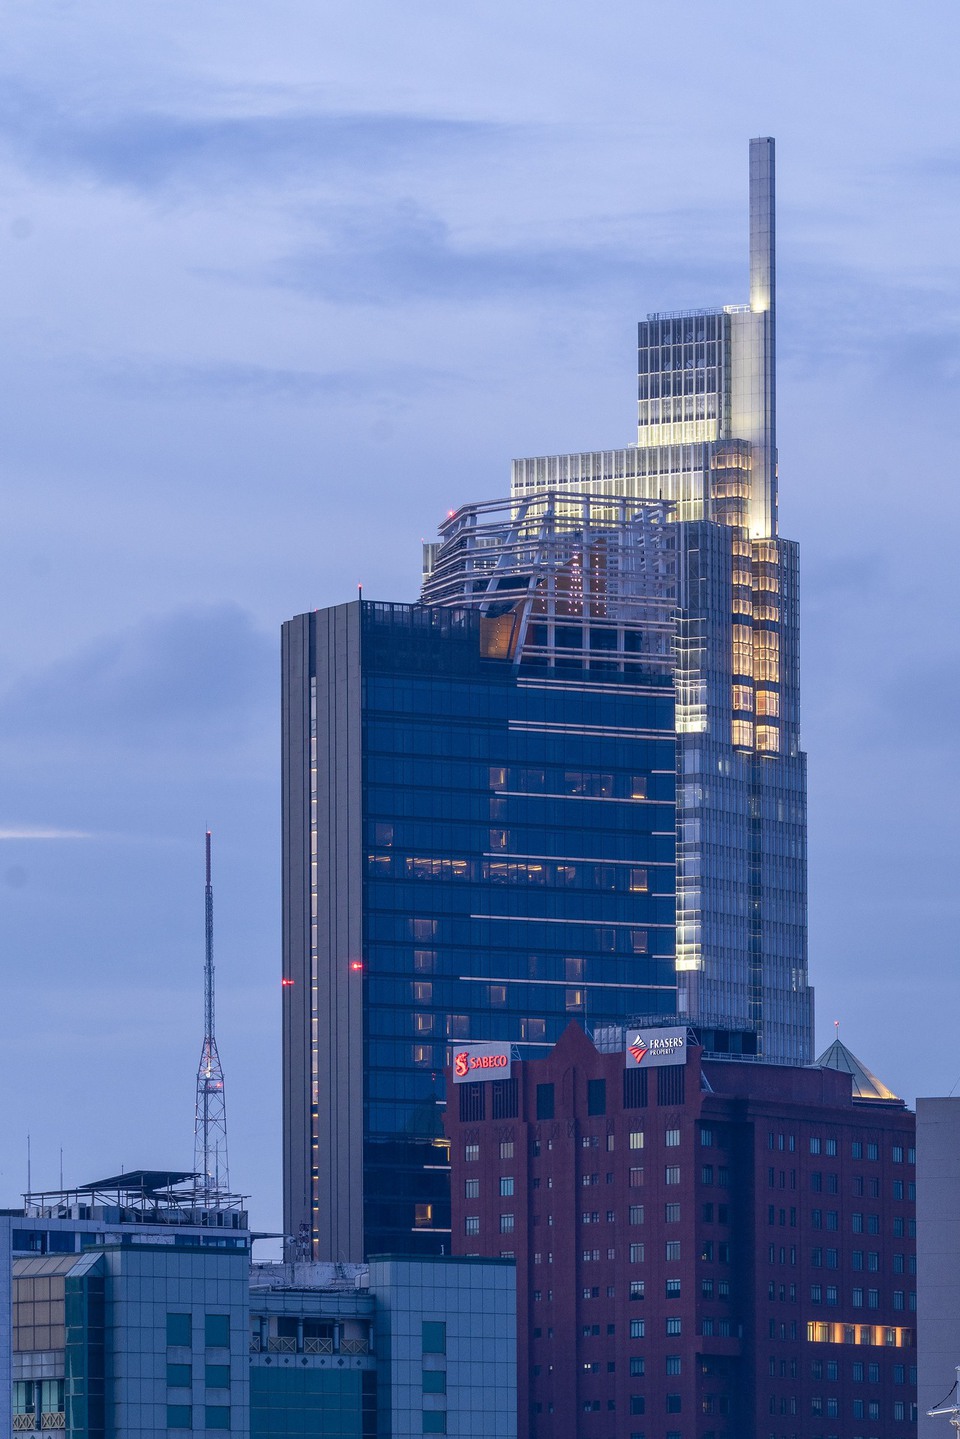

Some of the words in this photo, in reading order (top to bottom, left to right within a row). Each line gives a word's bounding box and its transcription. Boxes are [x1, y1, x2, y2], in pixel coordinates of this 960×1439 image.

[650, 1036, 684, 1049] FRASERS
[650, 1048, 675, 1056] PROPERTY
[470, 1055, 507, 1069] SABECO
